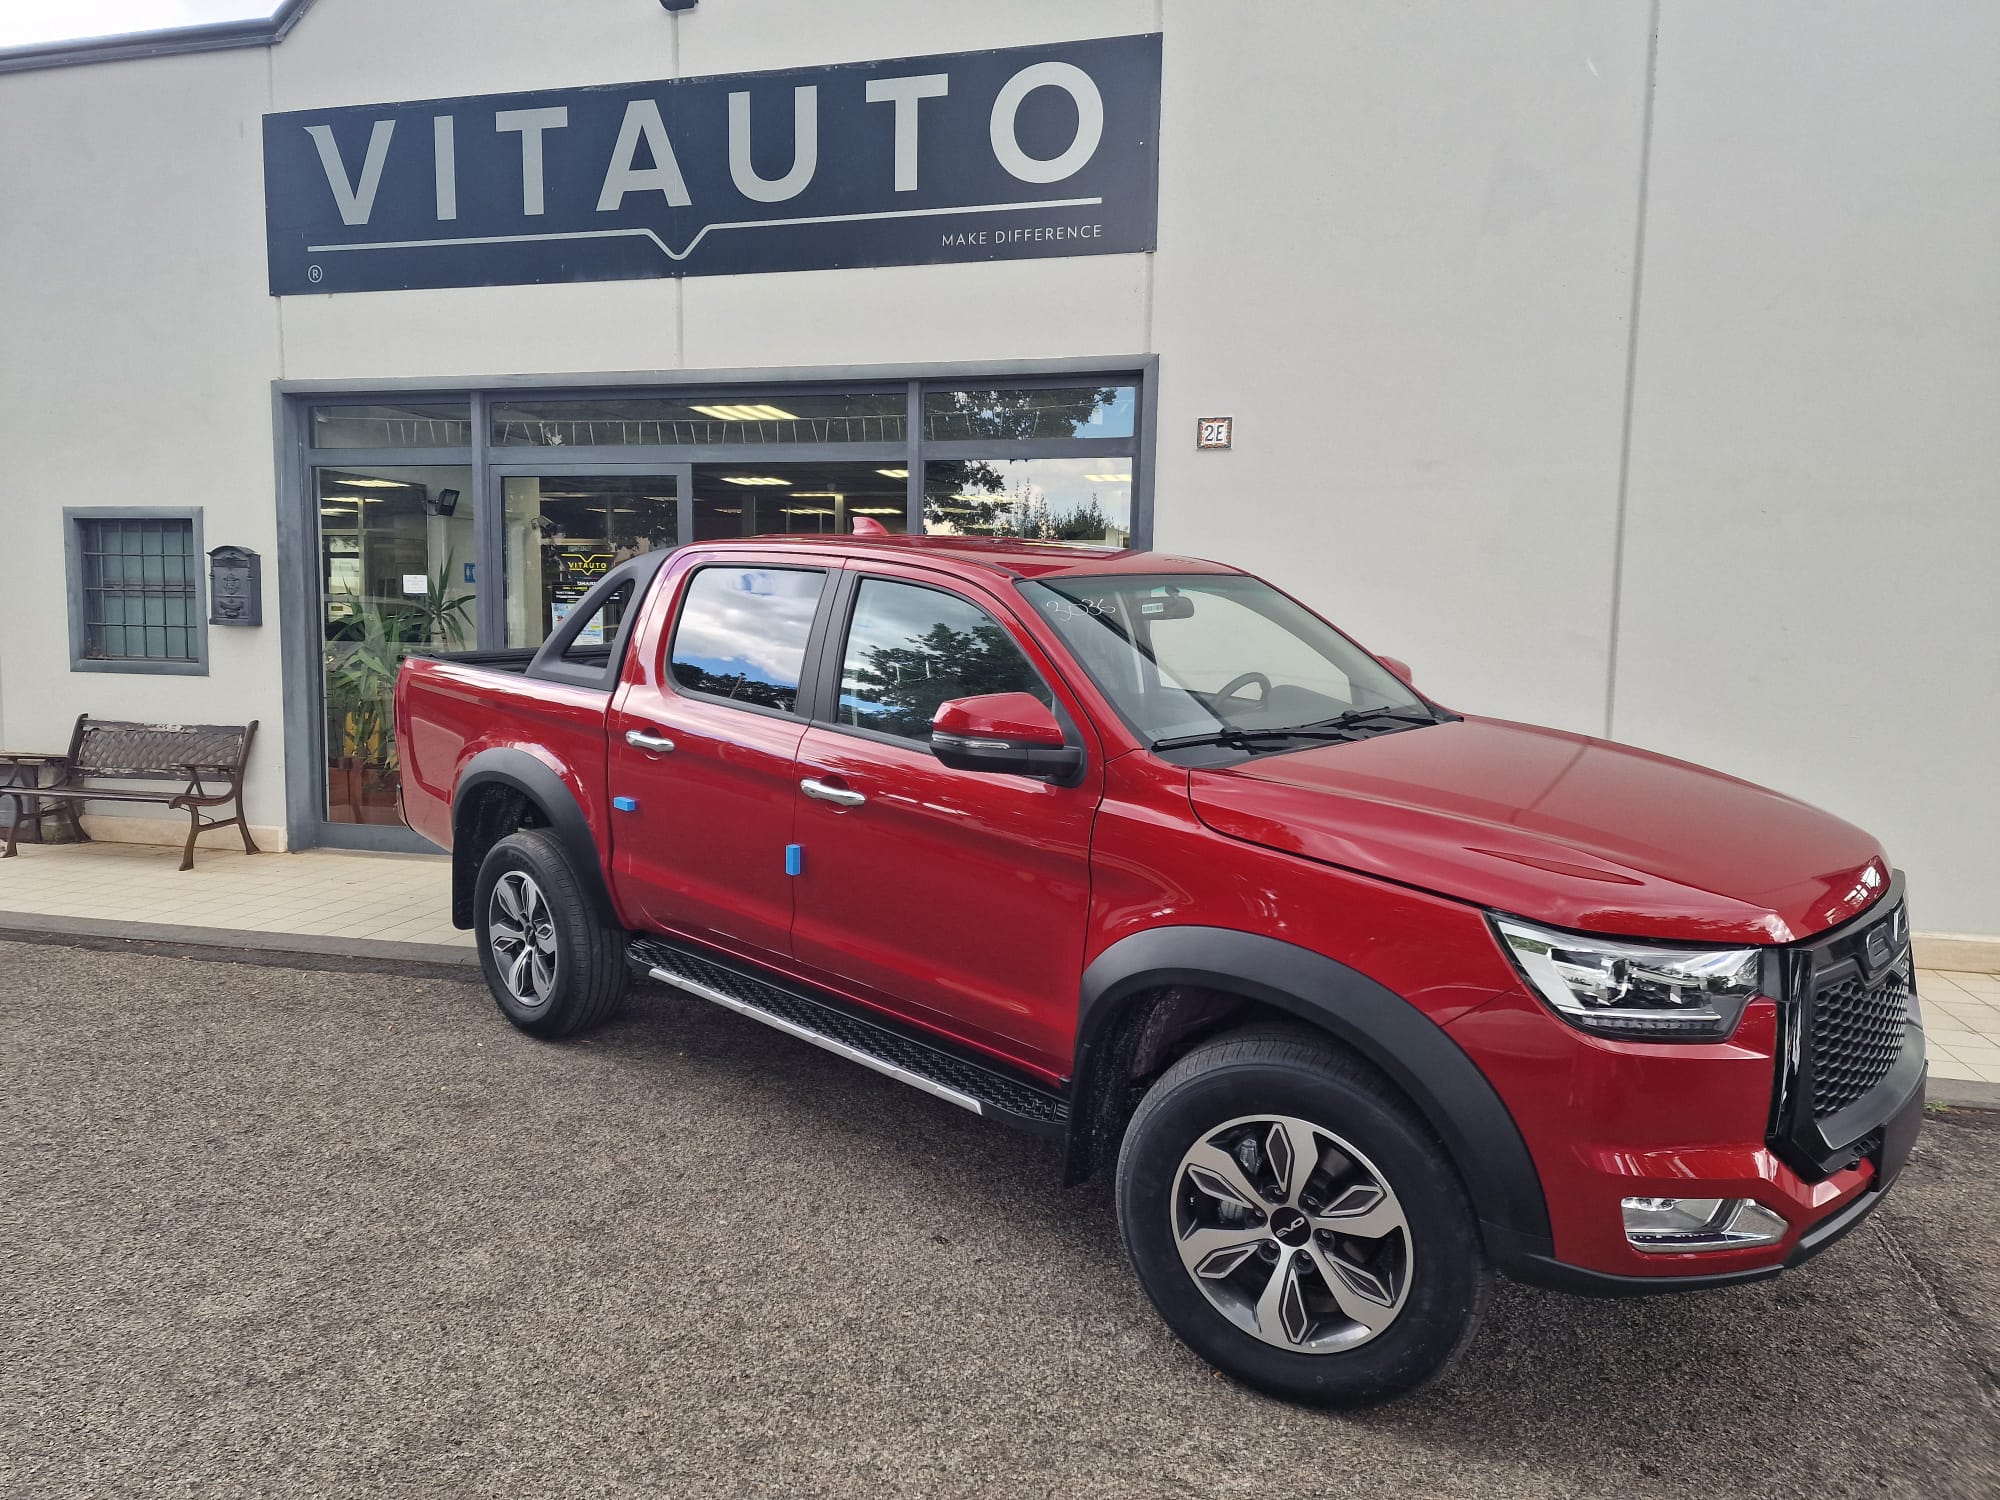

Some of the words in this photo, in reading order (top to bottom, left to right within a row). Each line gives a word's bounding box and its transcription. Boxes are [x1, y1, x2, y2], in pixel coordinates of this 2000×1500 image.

[304, 61, 1104, 226] VITAUTO
[942, 232, 987, 246] MAKE
[995, 225, 1102, 244] DIFFERENCE
[1205, 425, 1224, 442] 2E
